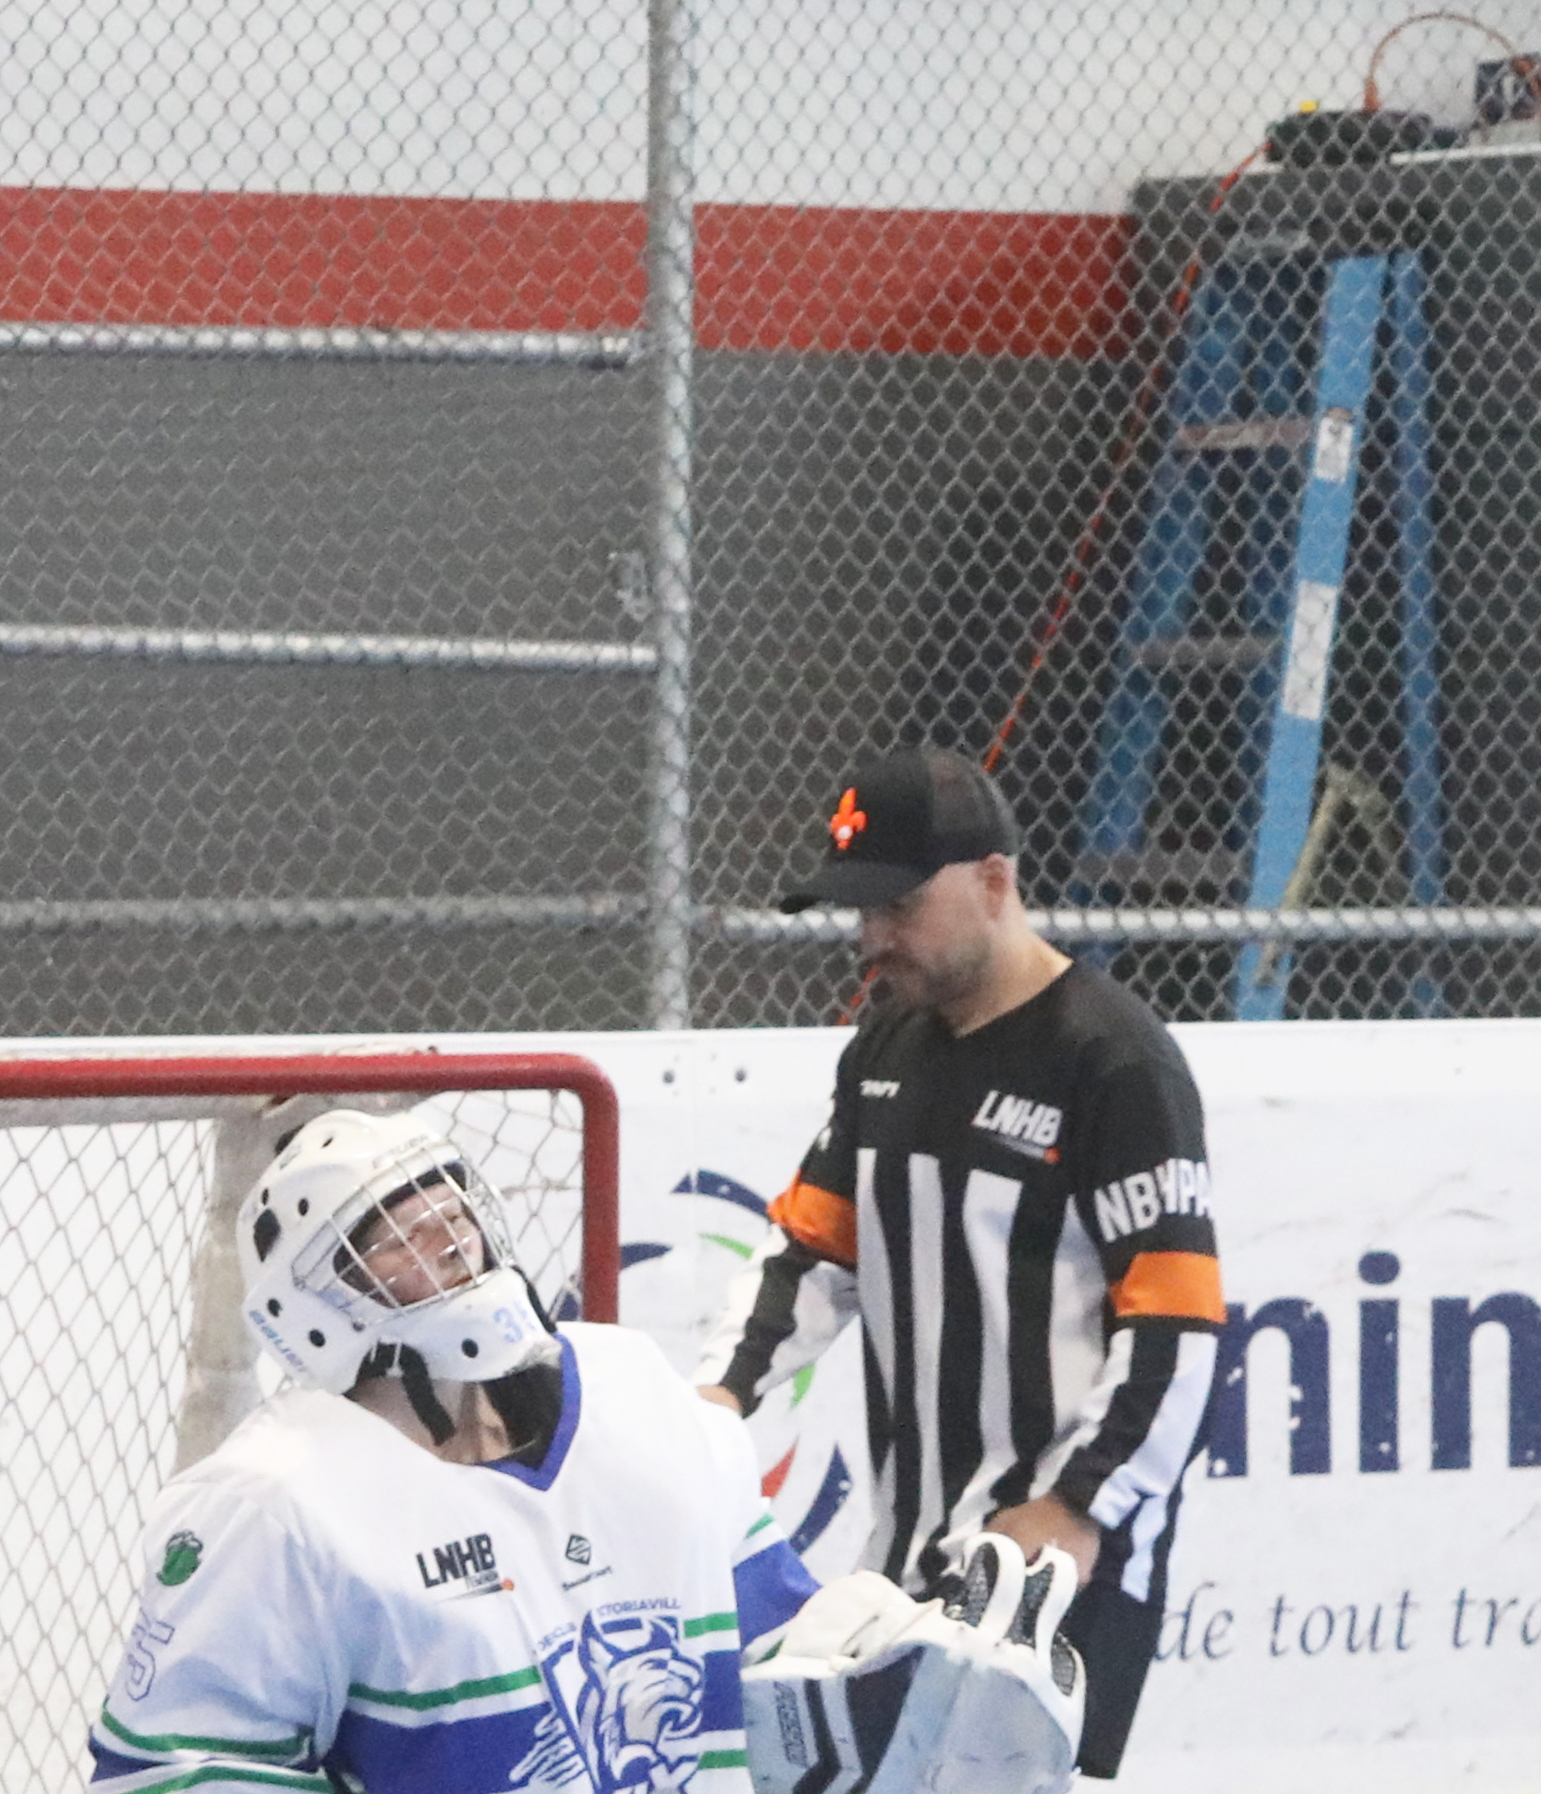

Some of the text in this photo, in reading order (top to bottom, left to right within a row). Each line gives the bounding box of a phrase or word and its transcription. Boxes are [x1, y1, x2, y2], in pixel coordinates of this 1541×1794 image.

[971, 1089, 1064, 1148] LNHB
[415, 1532, 497, 1589] LNHB
[1269, 1578, 1417, 1657] tout
